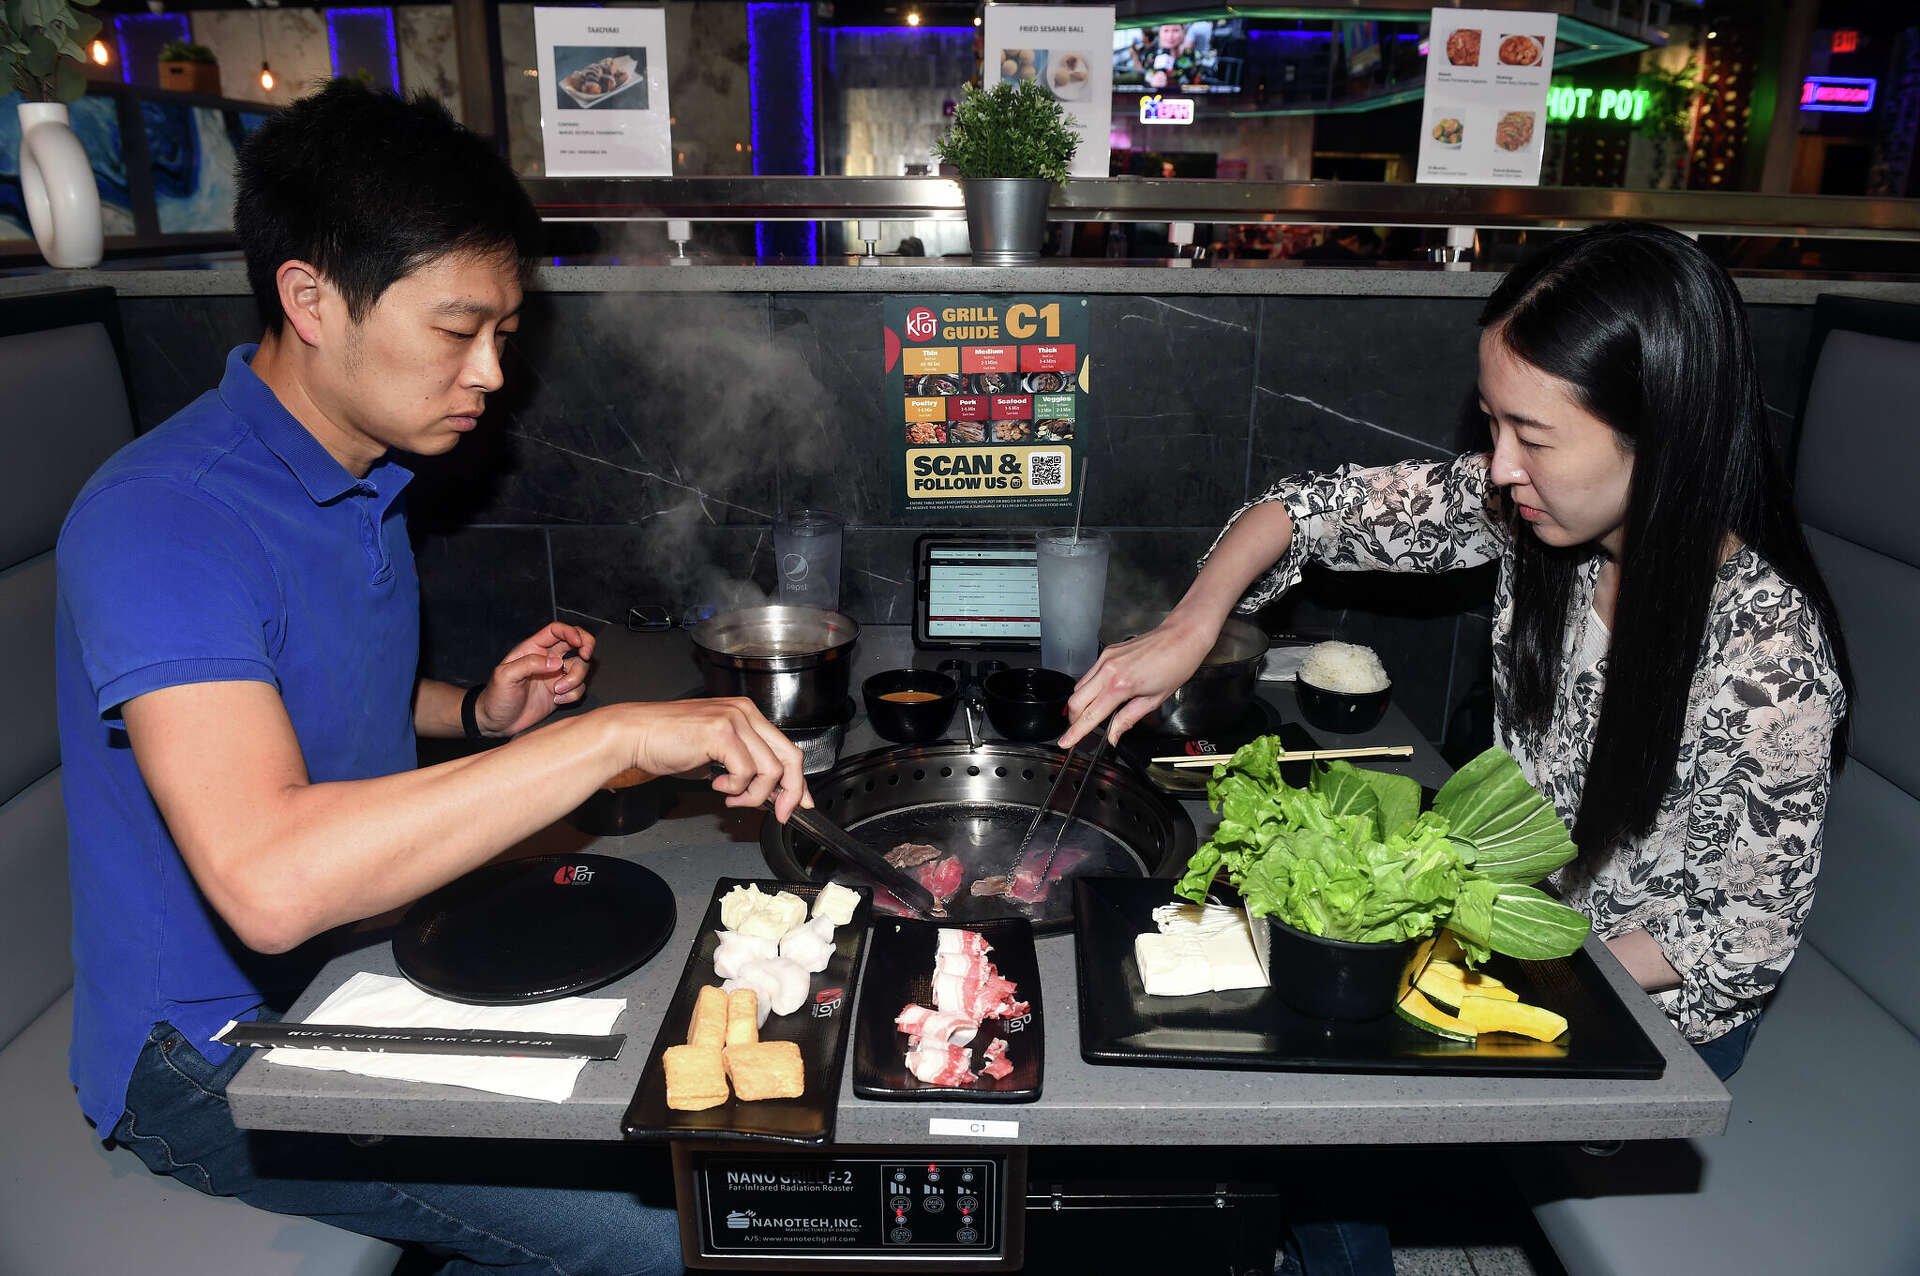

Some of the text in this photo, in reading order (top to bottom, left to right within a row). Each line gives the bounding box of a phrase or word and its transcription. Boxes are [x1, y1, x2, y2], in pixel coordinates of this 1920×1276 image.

[1599, 88, 1650, 120] POT
[942, 307, 998, 322] GRILL
[1005, 303, 1060, 339] C1
[942, 325, 999, 340] GUIDE
[913, 453, 1023, 476] SCAN &
[914, 476, 1008, 491] FOLLOW US
[1010, 1013, 1032, 1033] POT
[970, 1123, 985, 1133] C1
[727, 1171, 776, 1184] NANO
[828, 1171, 853, 1184] F-2
[728, 1184, 854, 1192] Far-Infrared Radiation Roaster
[752, 1218, 862, 1229] NANOTECH,INC.
